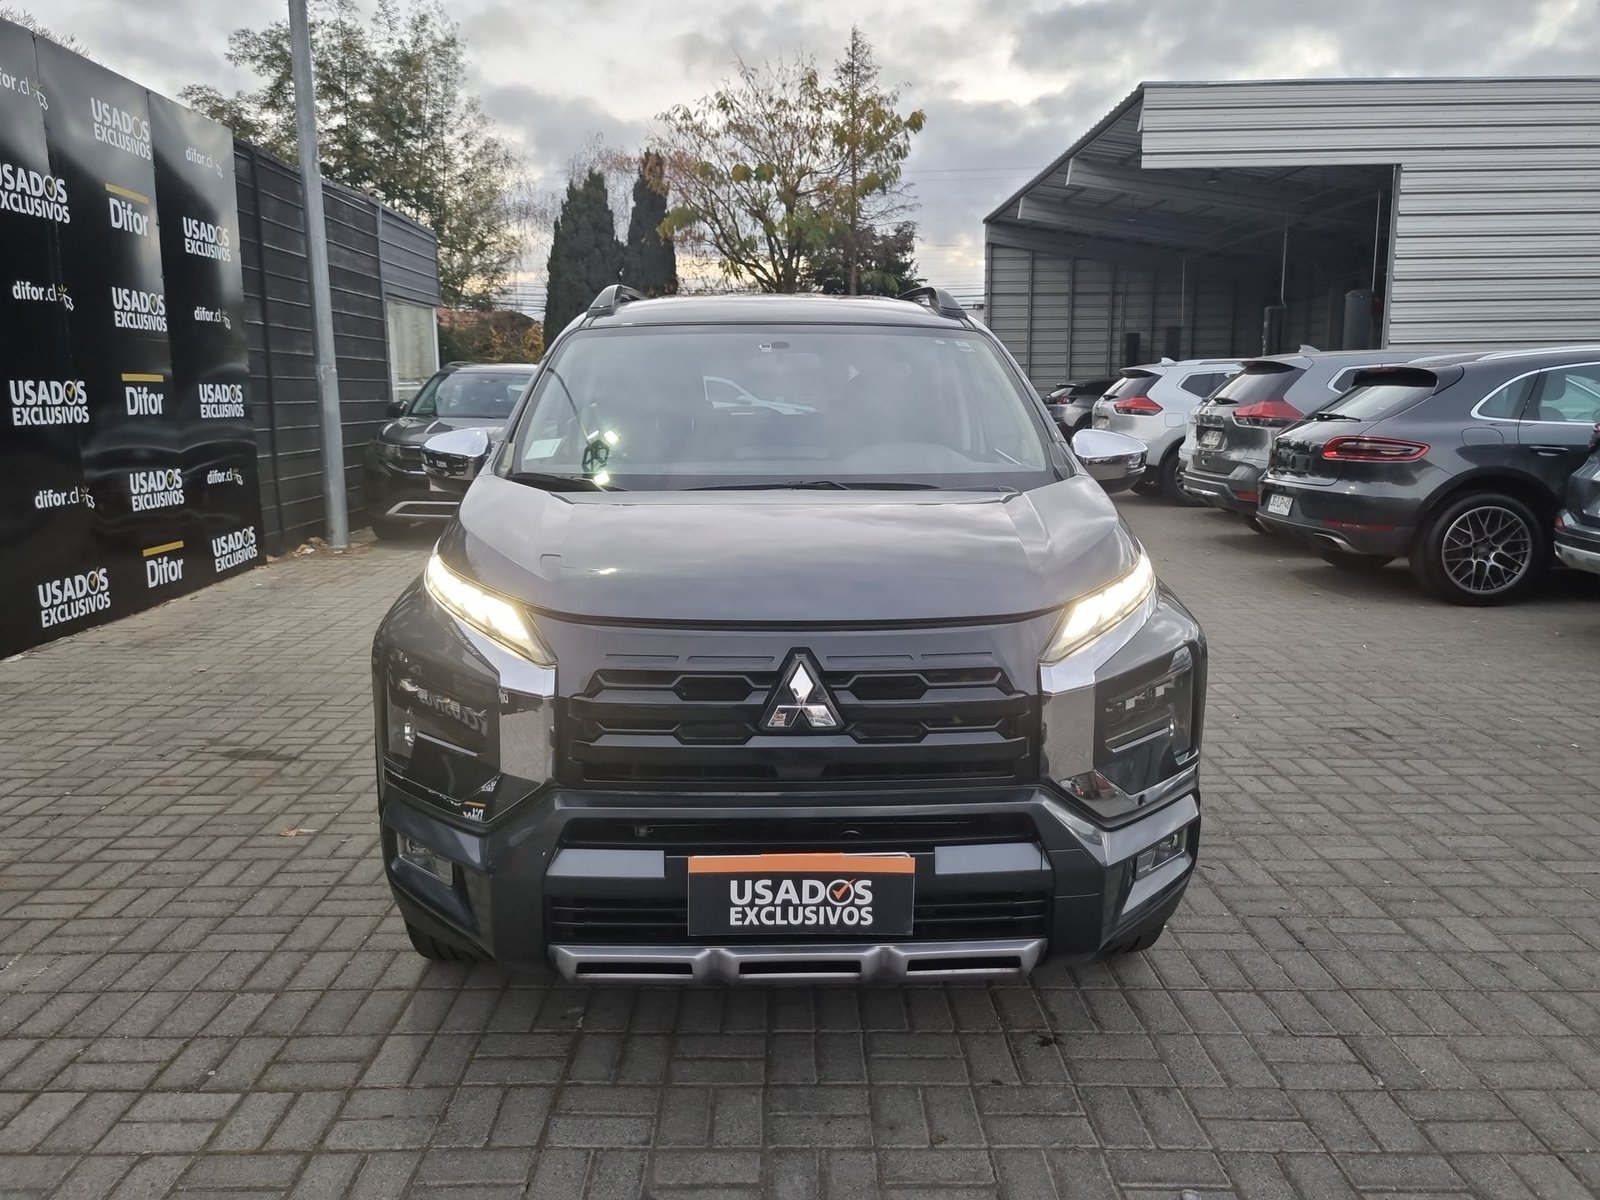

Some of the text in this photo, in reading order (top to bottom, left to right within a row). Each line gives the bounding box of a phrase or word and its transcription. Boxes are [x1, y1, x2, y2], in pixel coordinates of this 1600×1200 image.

[0, 67, 30, 96] or.cl
[90, 97, 150, 143] USADOS
[93, 123, 152, 161] EXCLUSIVOS
[185, 146, 213, 169] difor.cl
[0, 161, 68, 204] SADOS
[0, 189, 71, 224] XCLUSIVOS
[109, 197, 149, 237] Difor
[182, 216, 230, 248] USADOS
[184, 238, 232, 263] EXCLUSIVOS
[12, 280, 57, 302] difor.cl
[111, 286, 166, 316] USADOS
[114, 310, 168, 333] EXCLUSIVOS
[194, 305, 222, 323] difor.cl
[9, 379, 88, 406] USADOS
[125, 386, 164, 416] Difor
[199, 383, 243, 404] USADOS
[12, 405, 90, 426] EXCLUSIVOS
[200, 403, 245, 419] EXCLUSIVOS
[129, 468, 183, 495] USADOS
[207, 467, 233, 485] difor.cl
[34, 486, 80, 509] difor.cl
[131, 489, 185, 512] EXCLUSIVOS
[212, 525, 256, 558] USADOS
[215, 544, 258, 573] EXCLUSIVOS
[146, 556, 184, 589] Difor
[38, 567, 109, 609] USADOS
[41, 592, 111, 628] EXCLUSIVOS
[729, 879, 874, 906] USADOS
[729, 906, 874, 926] EXCLUSIVOS
